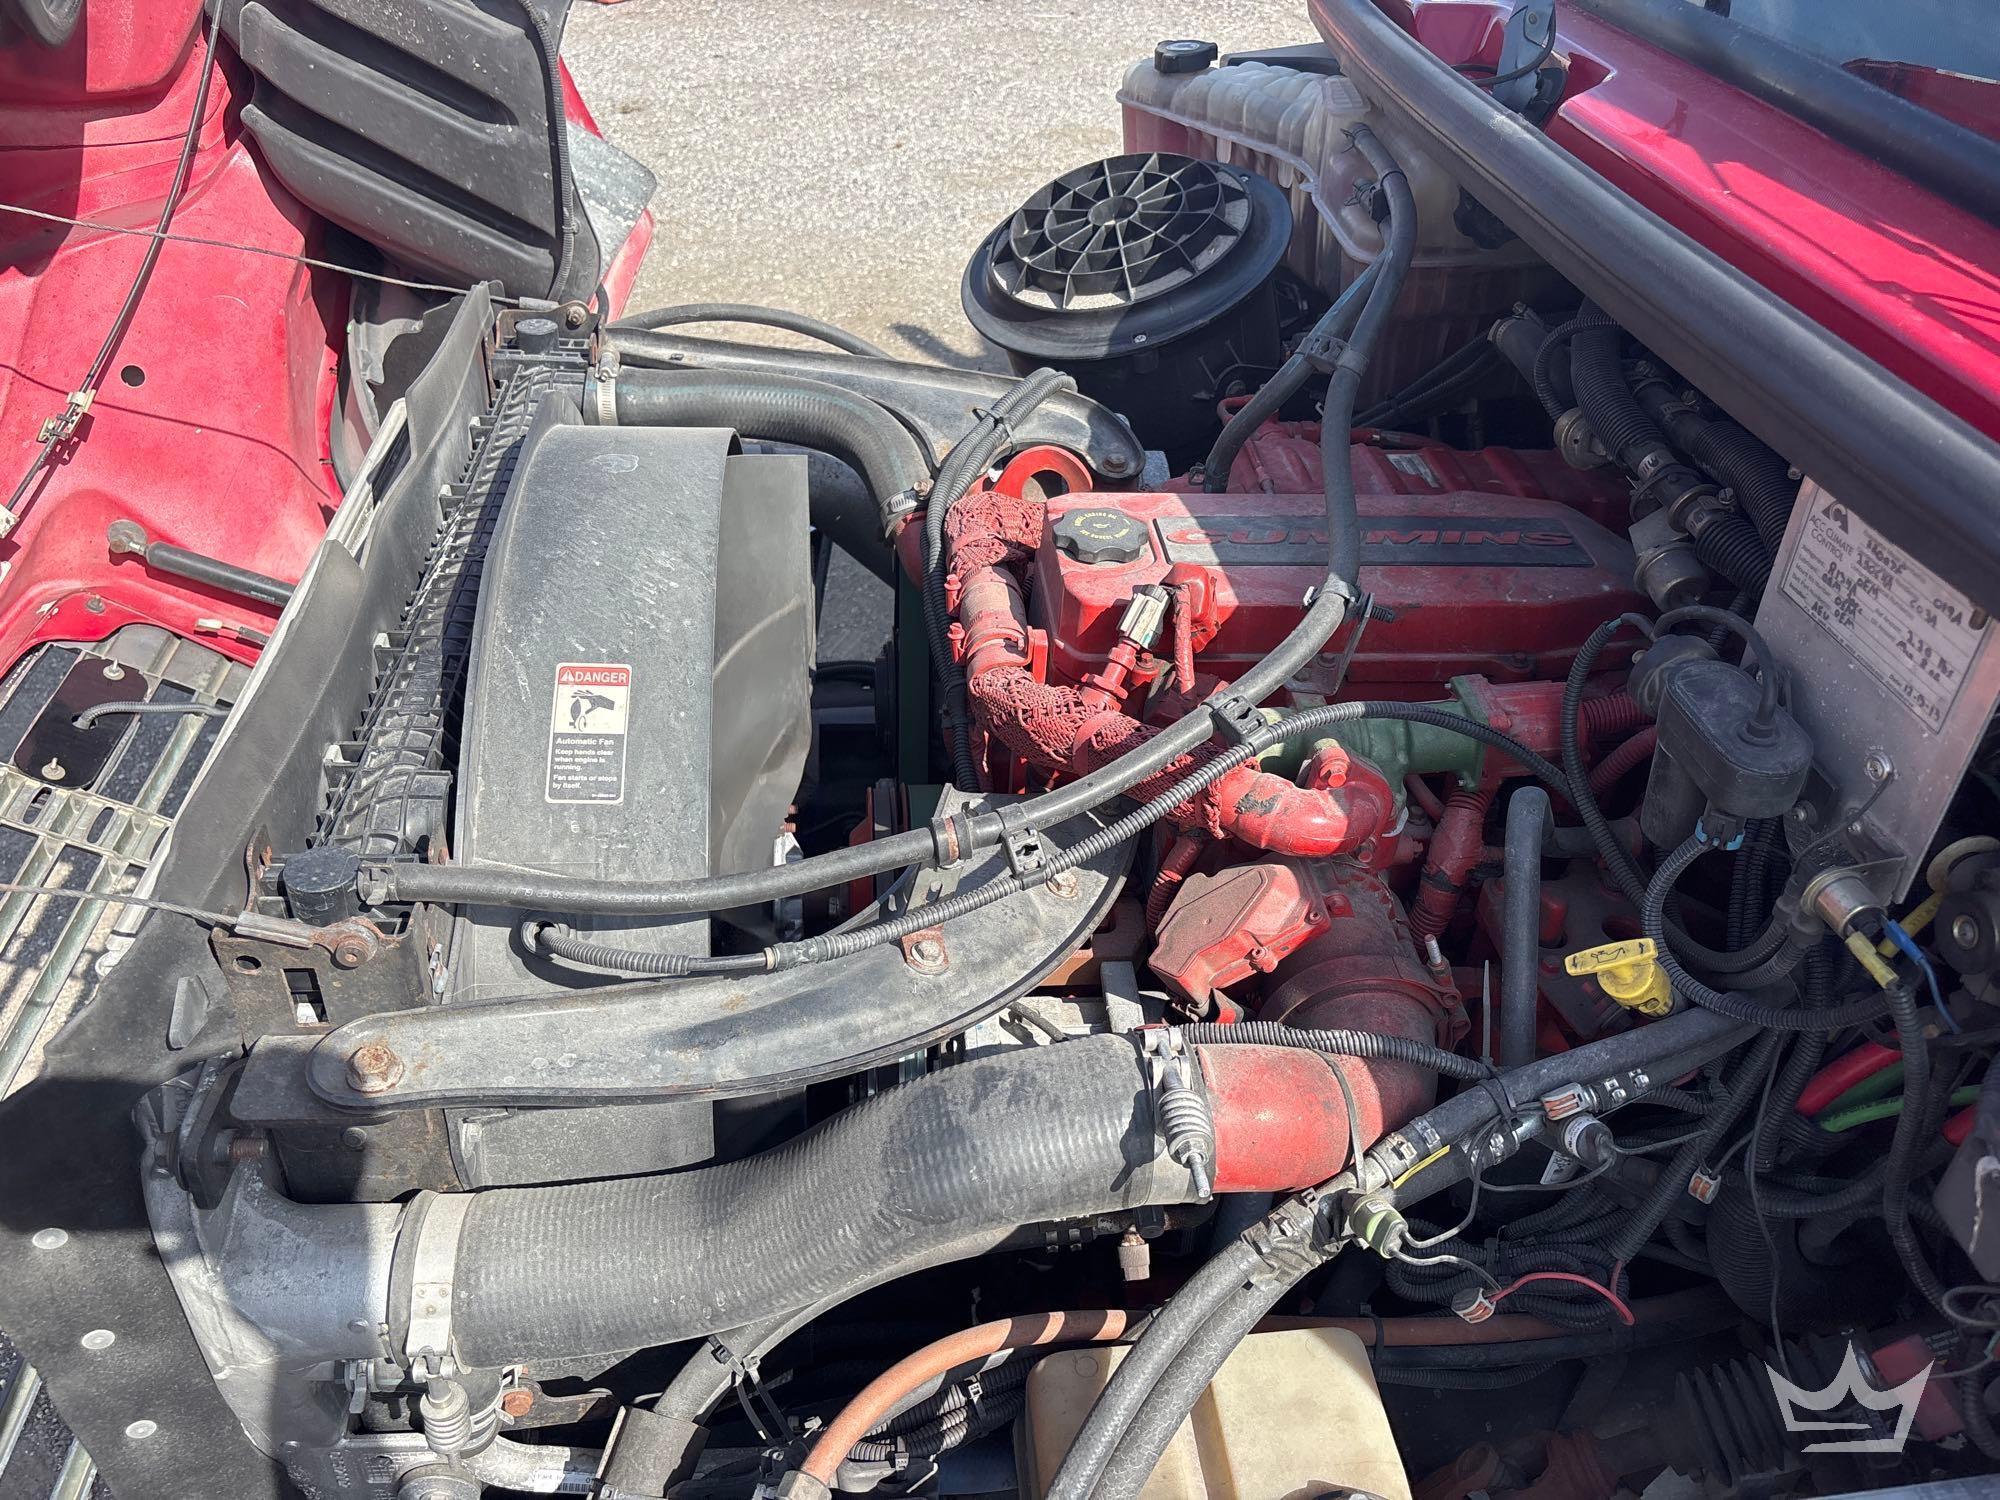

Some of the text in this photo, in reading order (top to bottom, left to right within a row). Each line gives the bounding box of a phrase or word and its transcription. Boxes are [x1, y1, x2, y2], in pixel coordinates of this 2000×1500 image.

[1809, 515, 1854, 556] ACC CLIMATE
[1811, 529, 1844, 562] CONTROL
[574, 672, 627, 684] DANGER
[556, 738, 614, 746] Automatic Fan
[555, 748, 573, 756] Keep
[575, 757, 597, 765] engine
[554, 764, 582, 772] running.
[598, 775, 617, 783] stops
[553, 782, 562, 790] by
